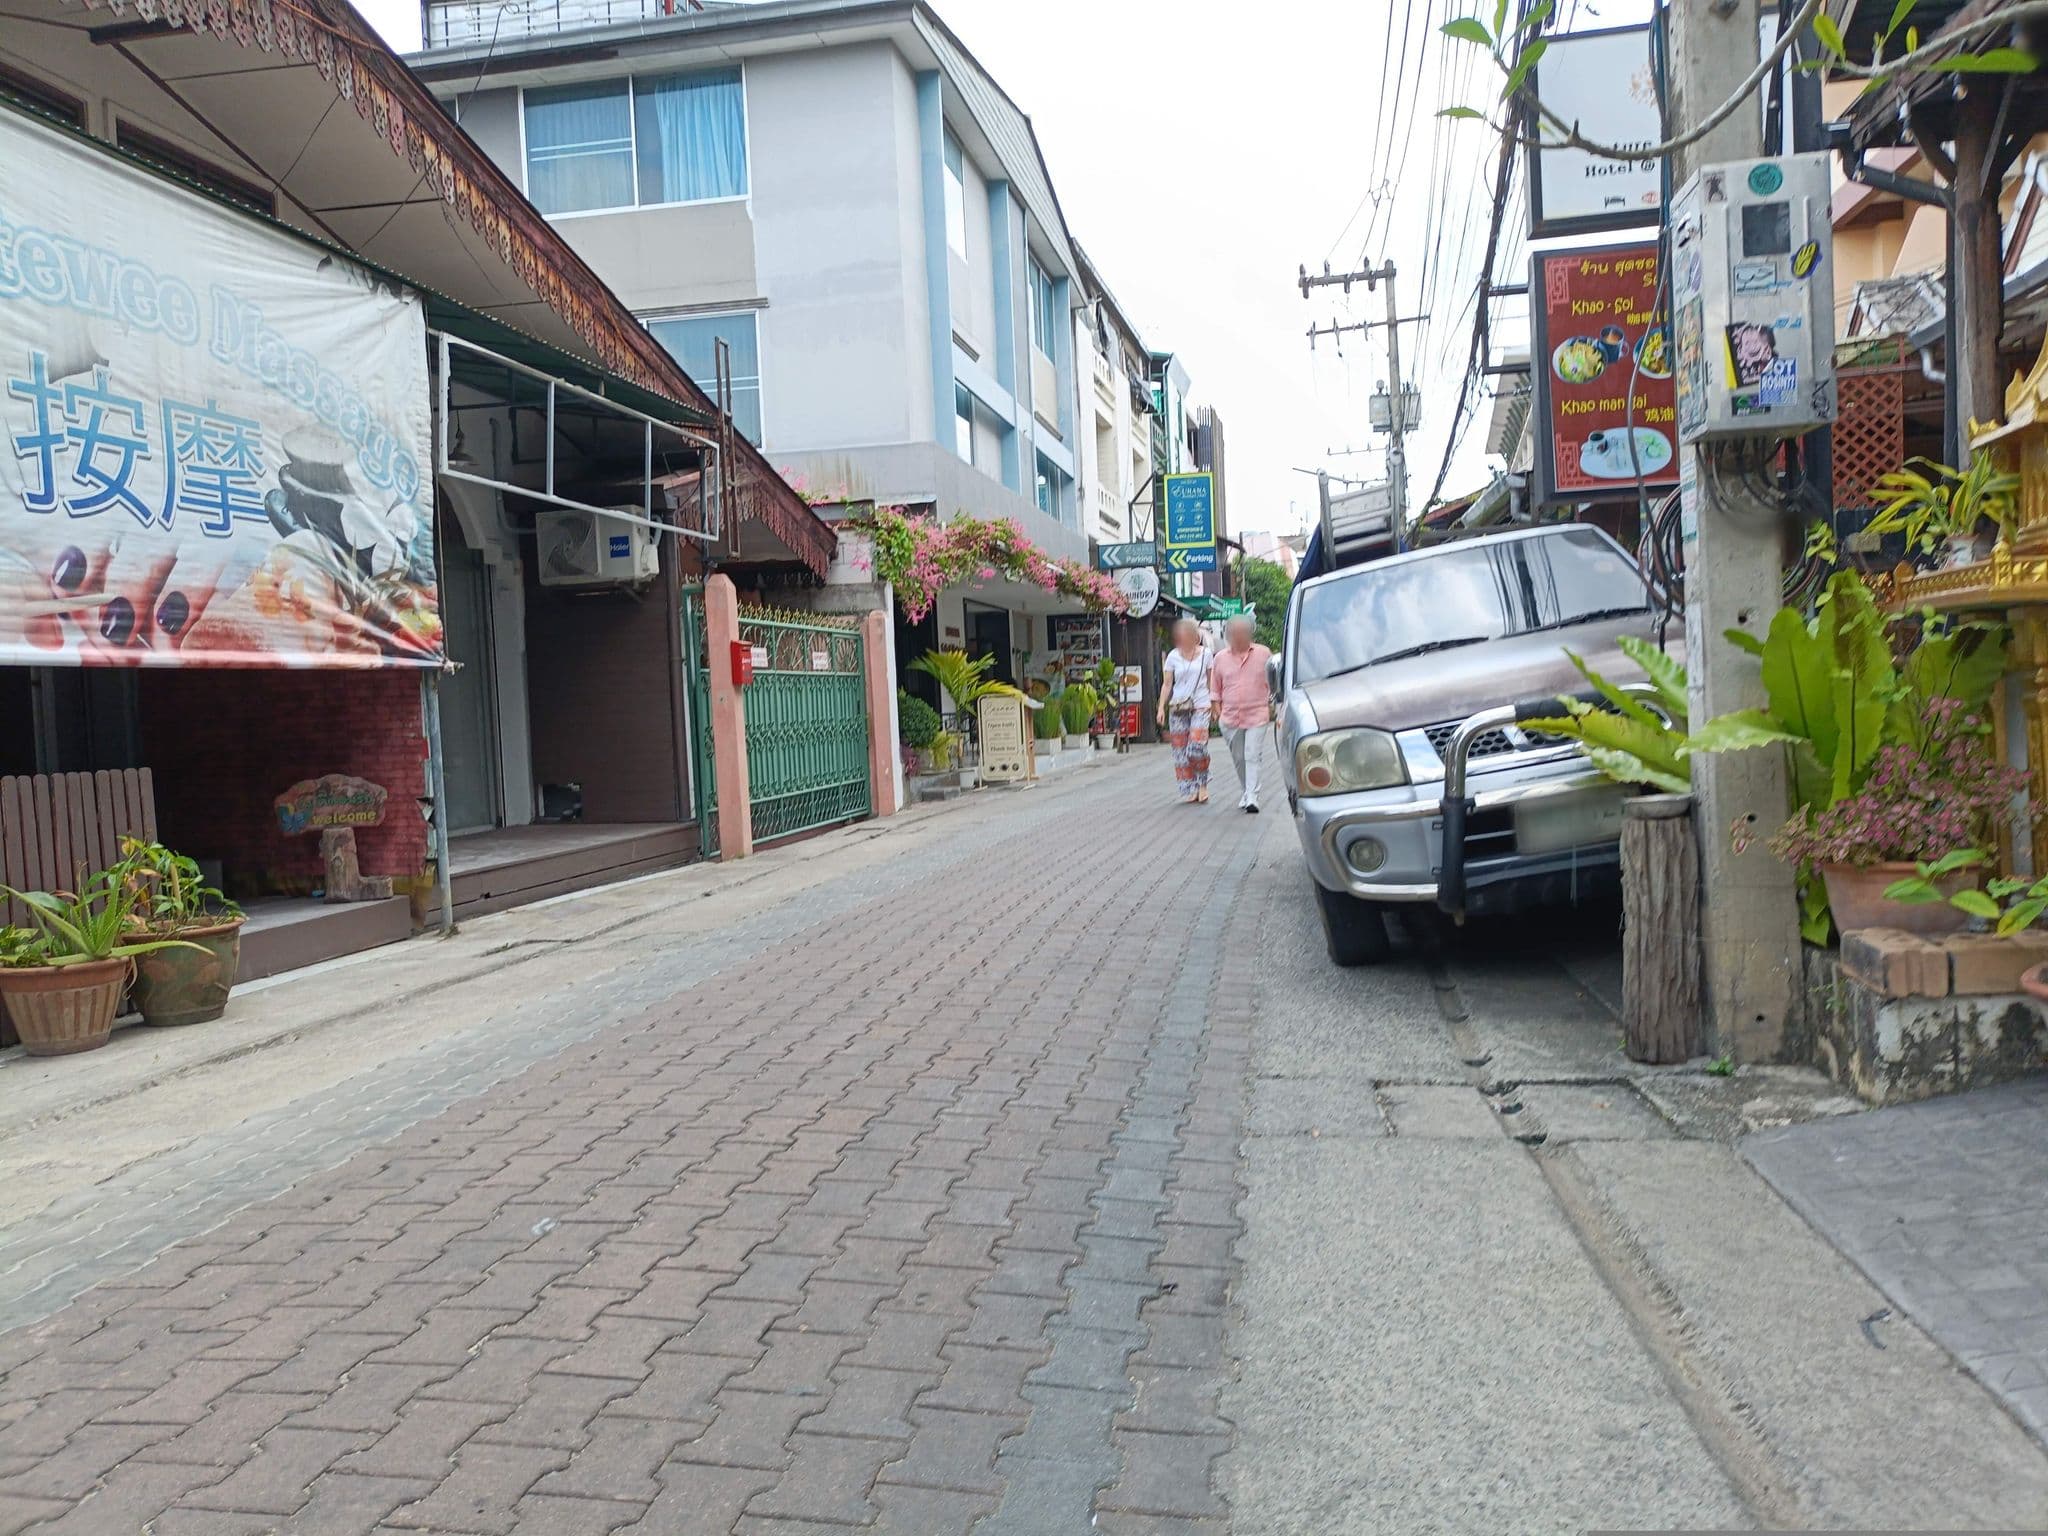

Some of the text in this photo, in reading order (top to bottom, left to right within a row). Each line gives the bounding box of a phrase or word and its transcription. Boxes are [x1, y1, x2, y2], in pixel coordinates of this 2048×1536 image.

[1585, 159, 1632, 177] Hotel
[1572, 299, 1604, 316] Khao
[209, 284, 421, 505] Massage
[1561, 399, 1596, 416] Khao
[1600, 397, 1625, 412] man
[8, 346, 270, 538] 按摩
[610, 543, 630, 552] Haier
[1126, 554, 1153, 564] Parking
[1186, 554, 1214, 564] Parking
[312, 810, 377, 825] welcome
